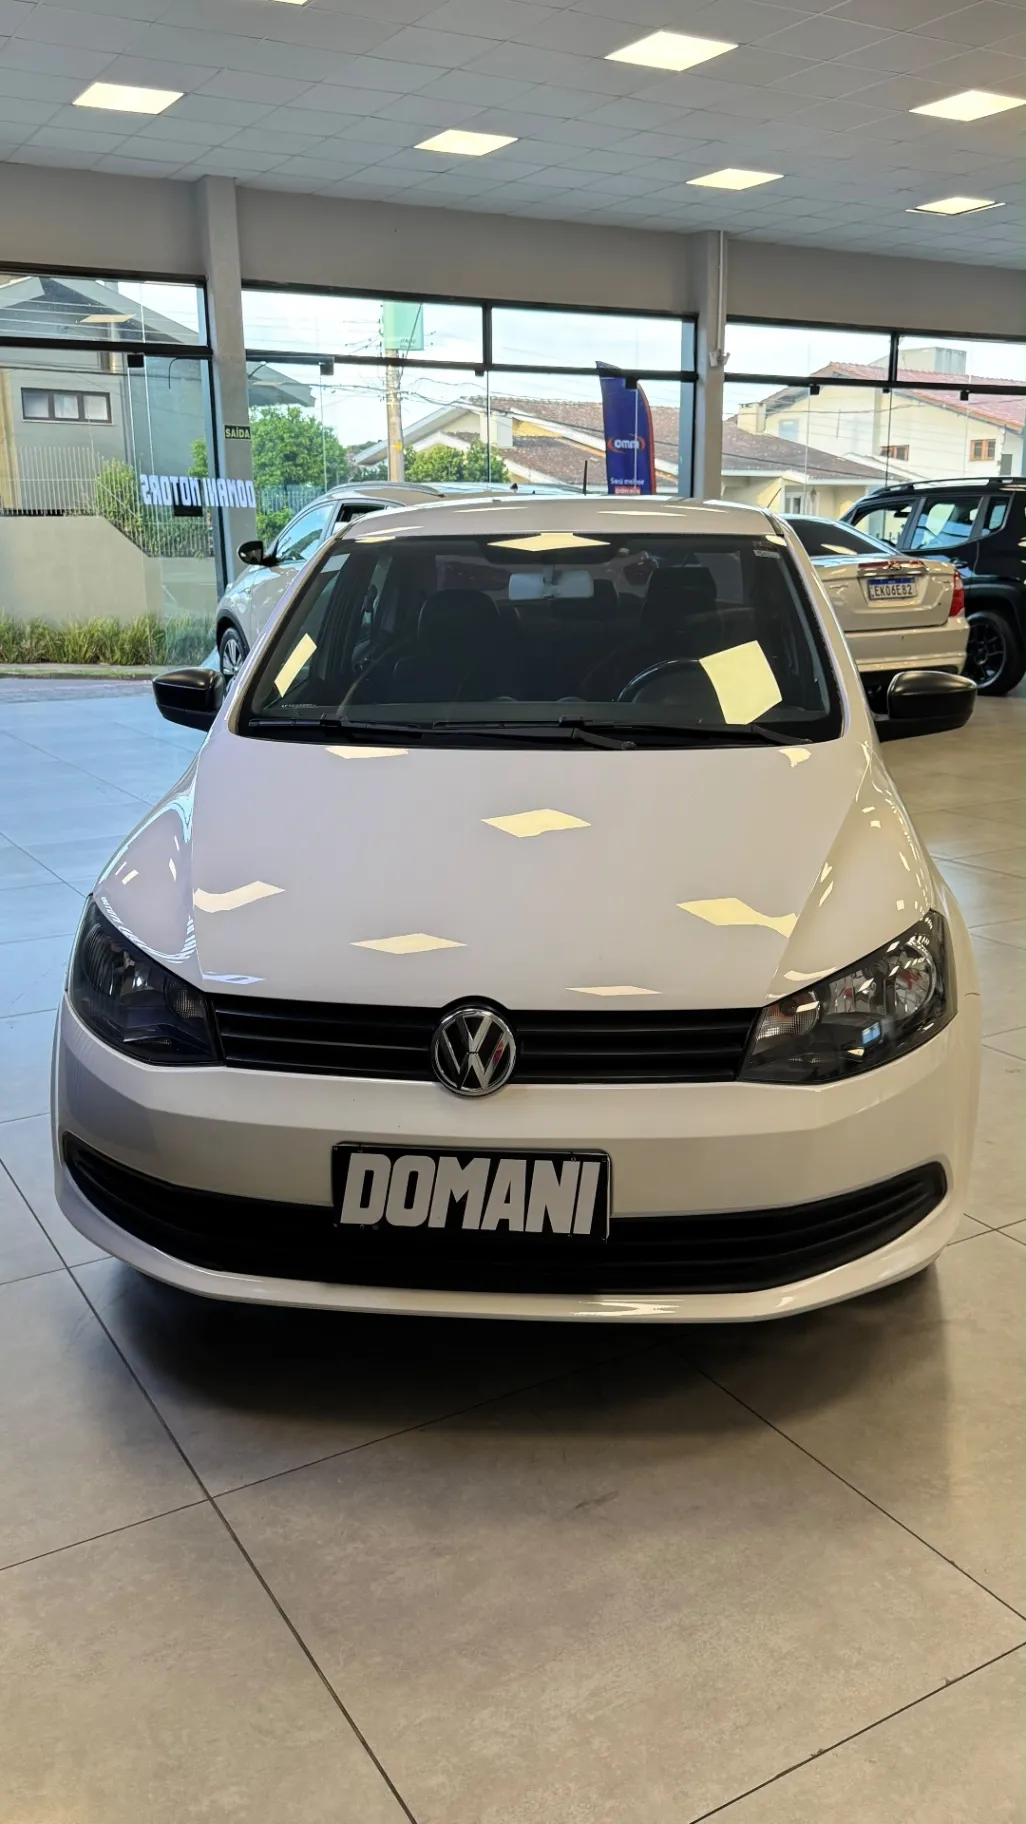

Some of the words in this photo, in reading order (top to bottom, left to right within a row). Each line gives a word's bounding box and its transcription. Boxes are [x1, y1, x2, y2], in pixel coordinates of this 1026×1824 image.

[225, 426, 250, 438] SAÍDA
[614, 439, 639, 449] omni
[340, 1152, 600, 1235] DOMANI
